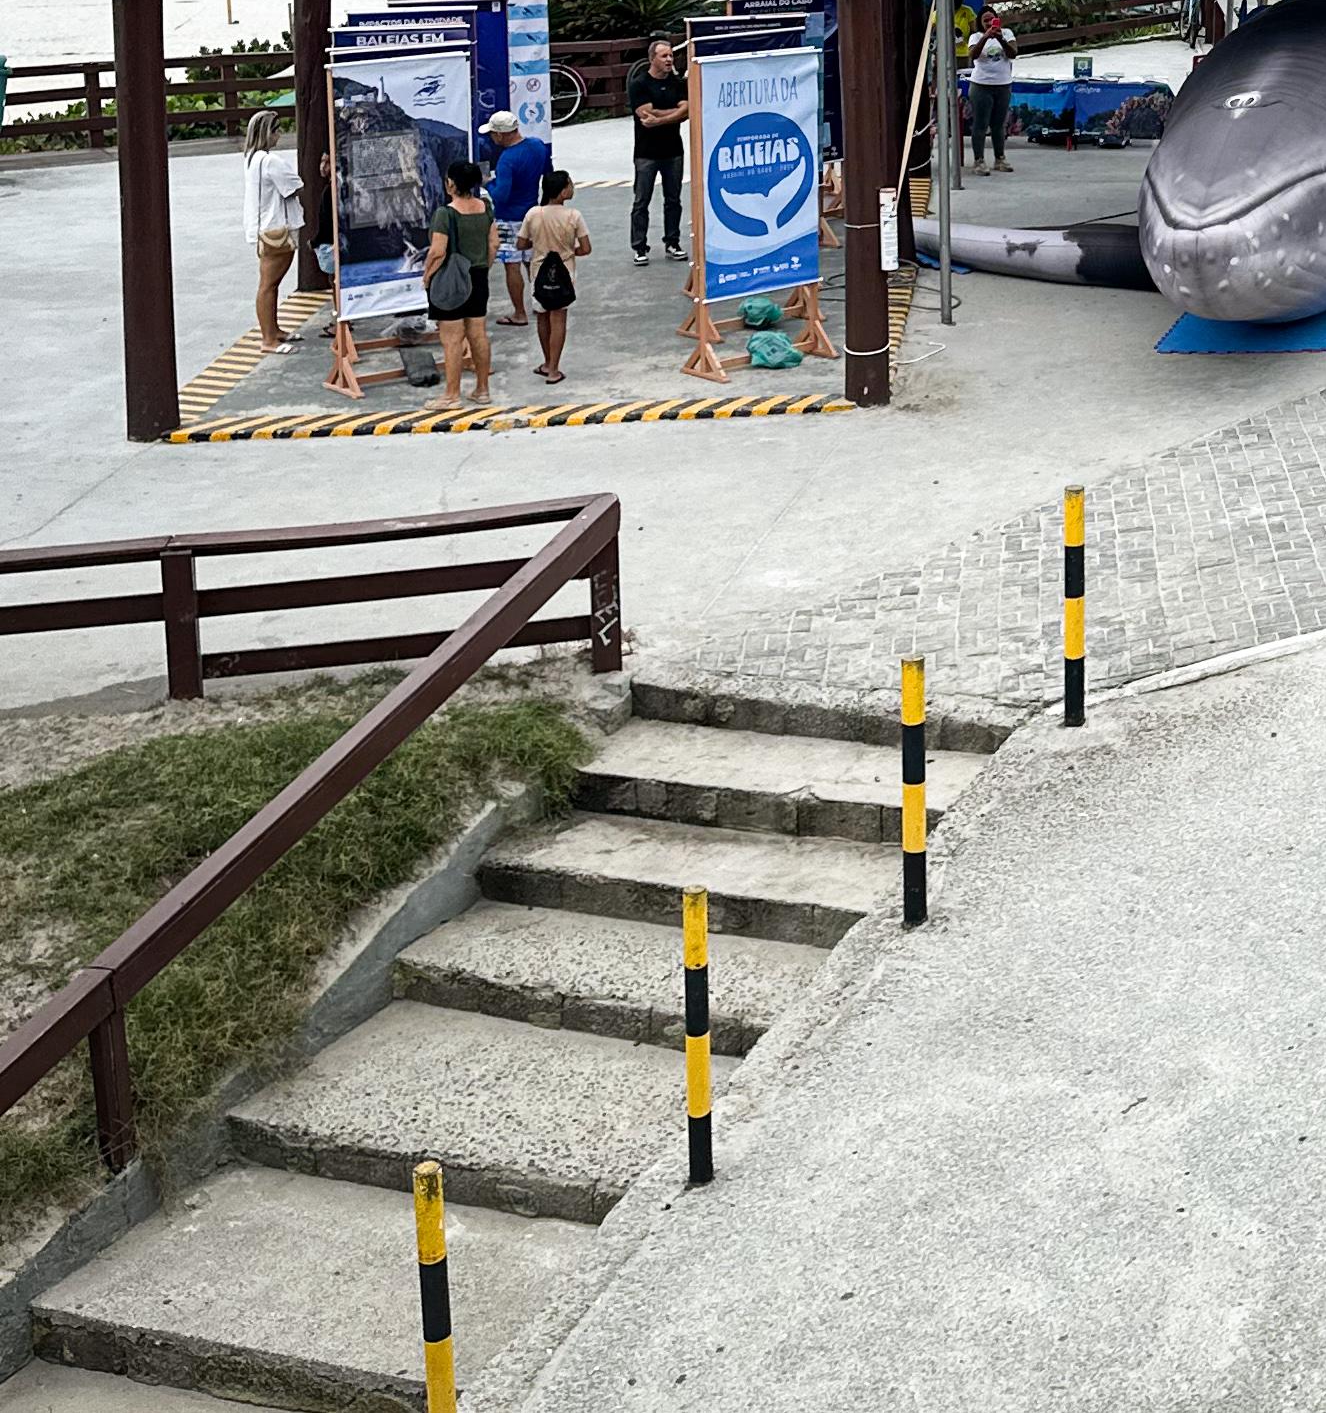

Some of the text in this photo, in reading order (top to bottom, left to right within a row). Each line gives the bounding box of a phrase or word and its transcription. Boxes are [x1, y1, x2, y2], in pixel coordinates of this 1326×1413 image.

[743, 0, 778, 8] ARRAIAL
[356, 32, 445, 47] BALEIAS EM
[718, 75, 799, 107] ABERTURA DA
[717, 137, 800, 171] BALEIAS
